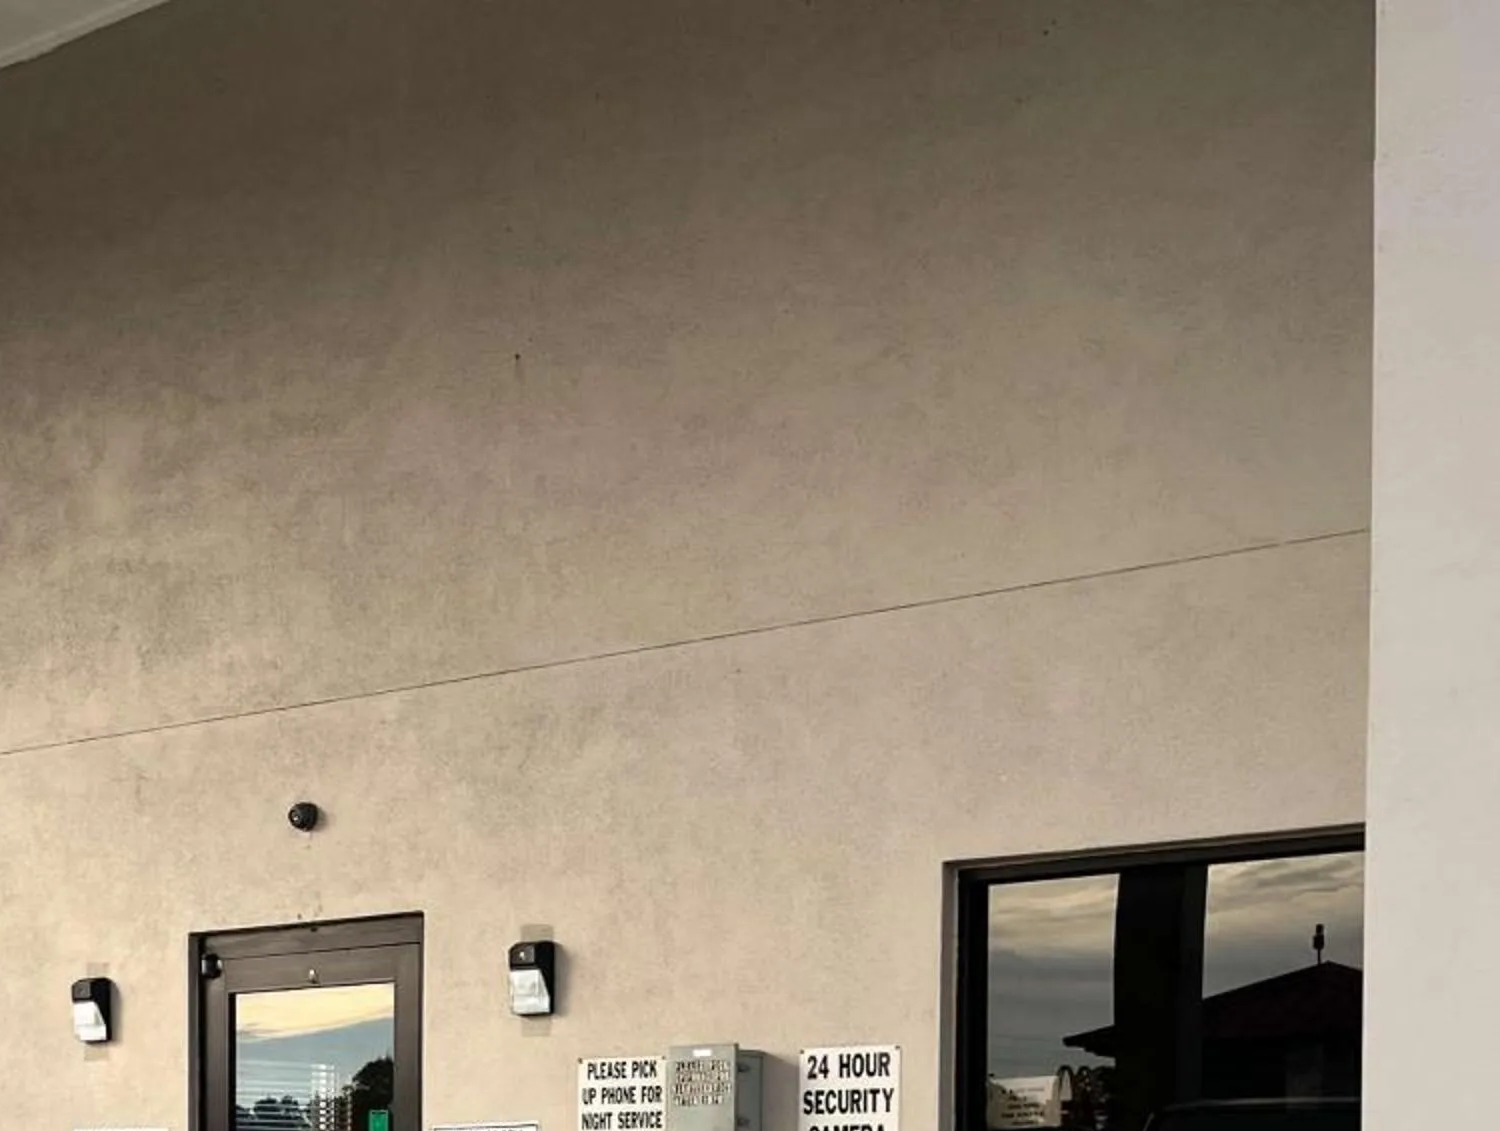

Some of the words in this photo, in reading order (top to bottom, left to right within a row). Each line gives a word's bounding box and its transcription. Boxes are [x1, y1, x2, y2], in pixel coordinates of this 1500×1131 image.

[587, 1061, 627, 1080] PLEASE
[631, 1060, 657, 1078] PICK
[807, 1055, 829, 1079] 24
[838, 1052, 891, 1078] HOUR
[582, 1087, 597, 1105] UP
[601, 1086, 637, 1104] PHONE
[641, 1085, 663, 1103] FOR
[803, 1088, 894, 1115] SECURITY
[581, 1112, 613, 1130] NIGHT
[617, 1111, 663, 1129] SERVICE
